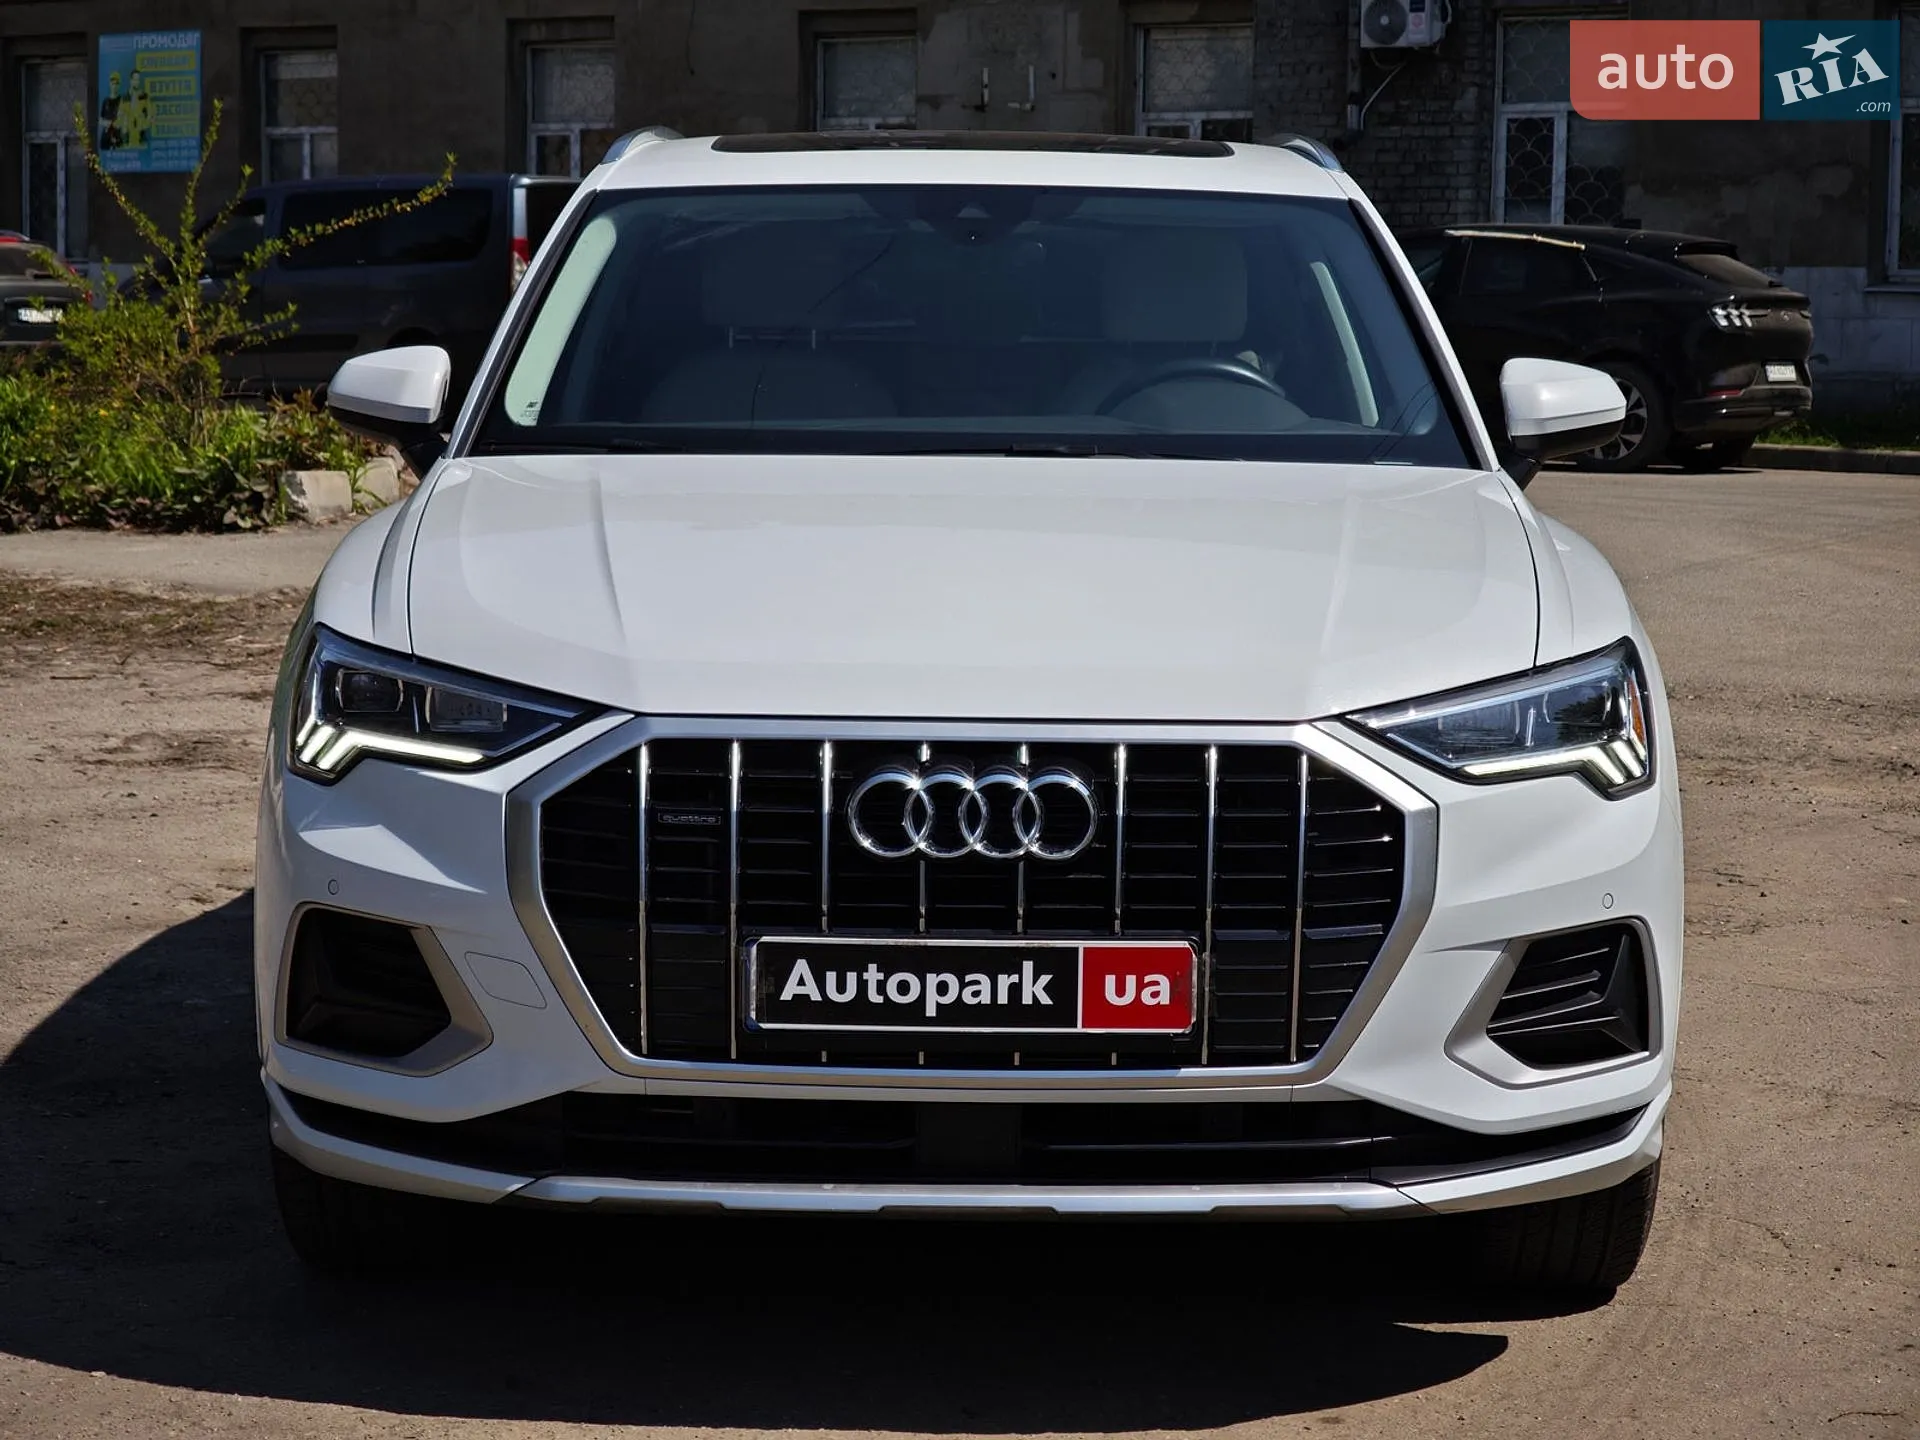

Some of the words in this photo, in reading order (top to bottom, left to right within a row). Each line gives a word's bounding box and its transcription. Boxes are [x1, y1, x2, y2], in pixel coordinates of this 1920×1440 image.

[133, 32, 200, 49] ПРОМОДЯГ
[779, 958, 1054, 1017] Autopark
[1104, 973, 1171, 1005] ua
